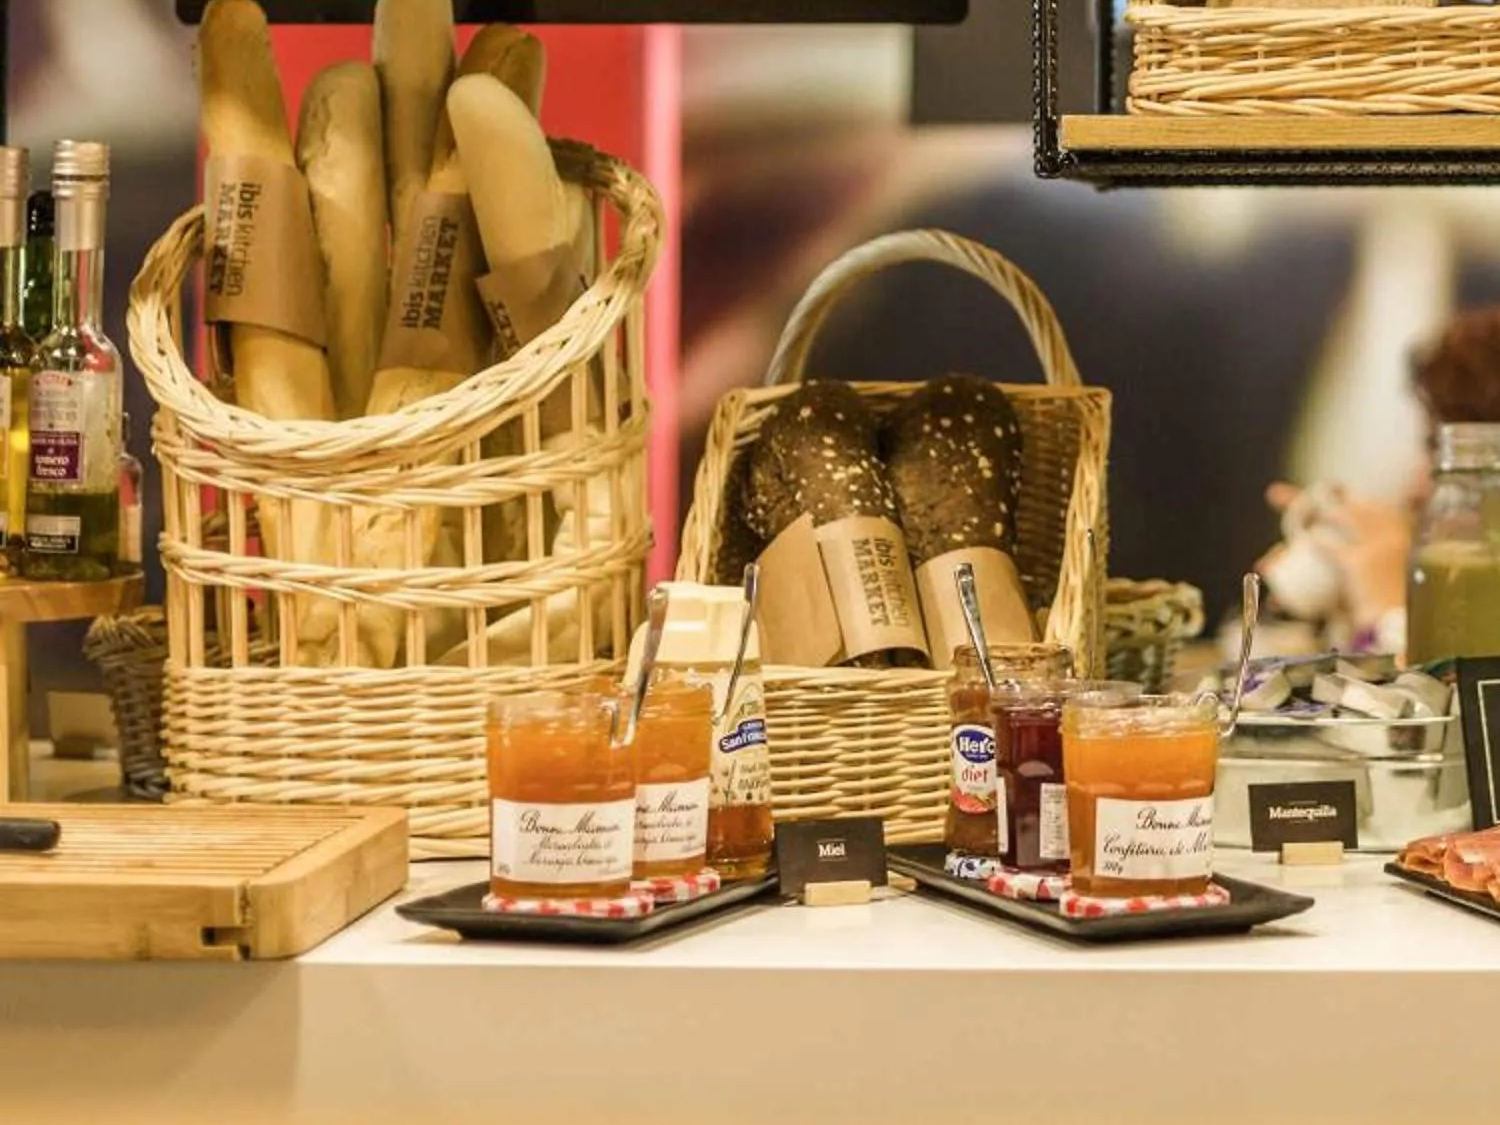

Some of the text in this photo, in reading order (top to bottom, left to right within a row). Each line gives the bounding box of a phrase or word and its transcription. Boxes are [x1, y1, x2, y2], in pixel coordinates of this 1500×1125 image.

[209, 183, 236, 295] MARKET
[226, 182, 261, 296] ibis kitchen
[402, 216, 439, 328] ibis kitchen
[423, 217, 459, 330] MARKET
[874, 538, 897, 567] ibis
[851, 539, 890, 626] MARKET
[959, 737, 995, 754] Hero
[962, 767, 988, 782] diet
[519, 809, 561, 834] Bonne
[1135, 806, 1181, 830] Bonne
[1268, 804, 1338, 821] Mantequilla
[818, 843, 846, 858] Miel
